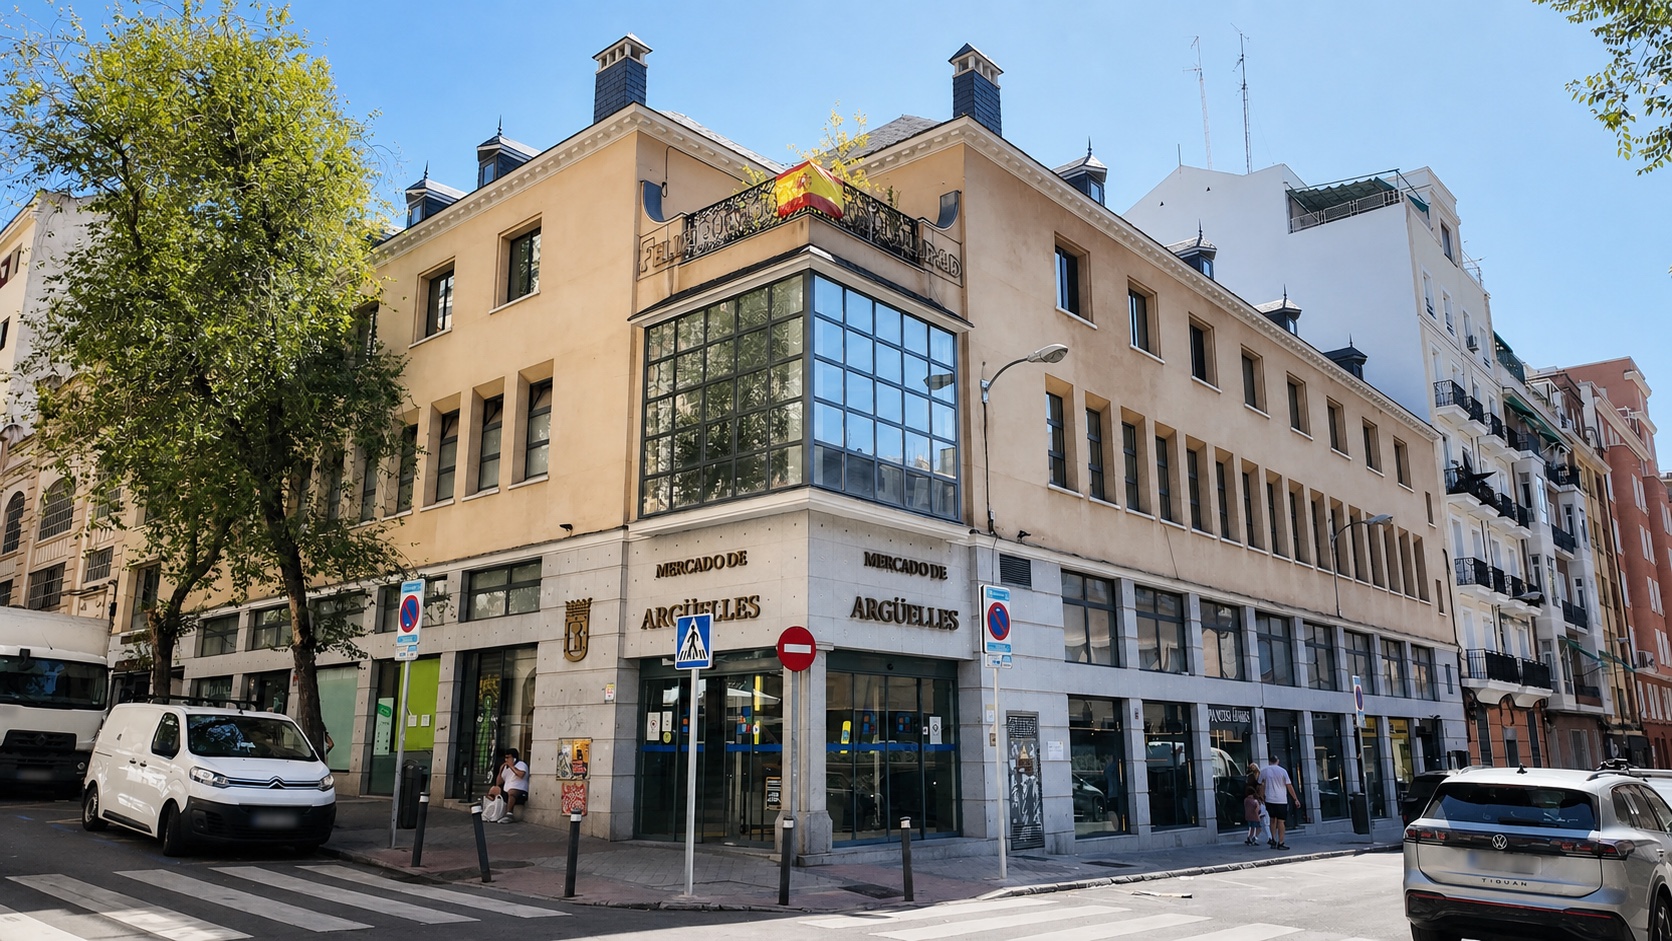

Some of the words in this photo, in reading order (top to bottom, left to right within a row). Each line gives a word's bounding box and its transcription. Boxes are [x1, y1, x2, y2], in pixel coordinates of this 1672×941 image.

[655, 554, 725, 579] MERCADO
[726, 550, 748, 568] DE
[863, 551, 929, 577] MERCADO
[929, 563, 948, 580] DE
[850, 596, 960, 631] ARGÜELLES
